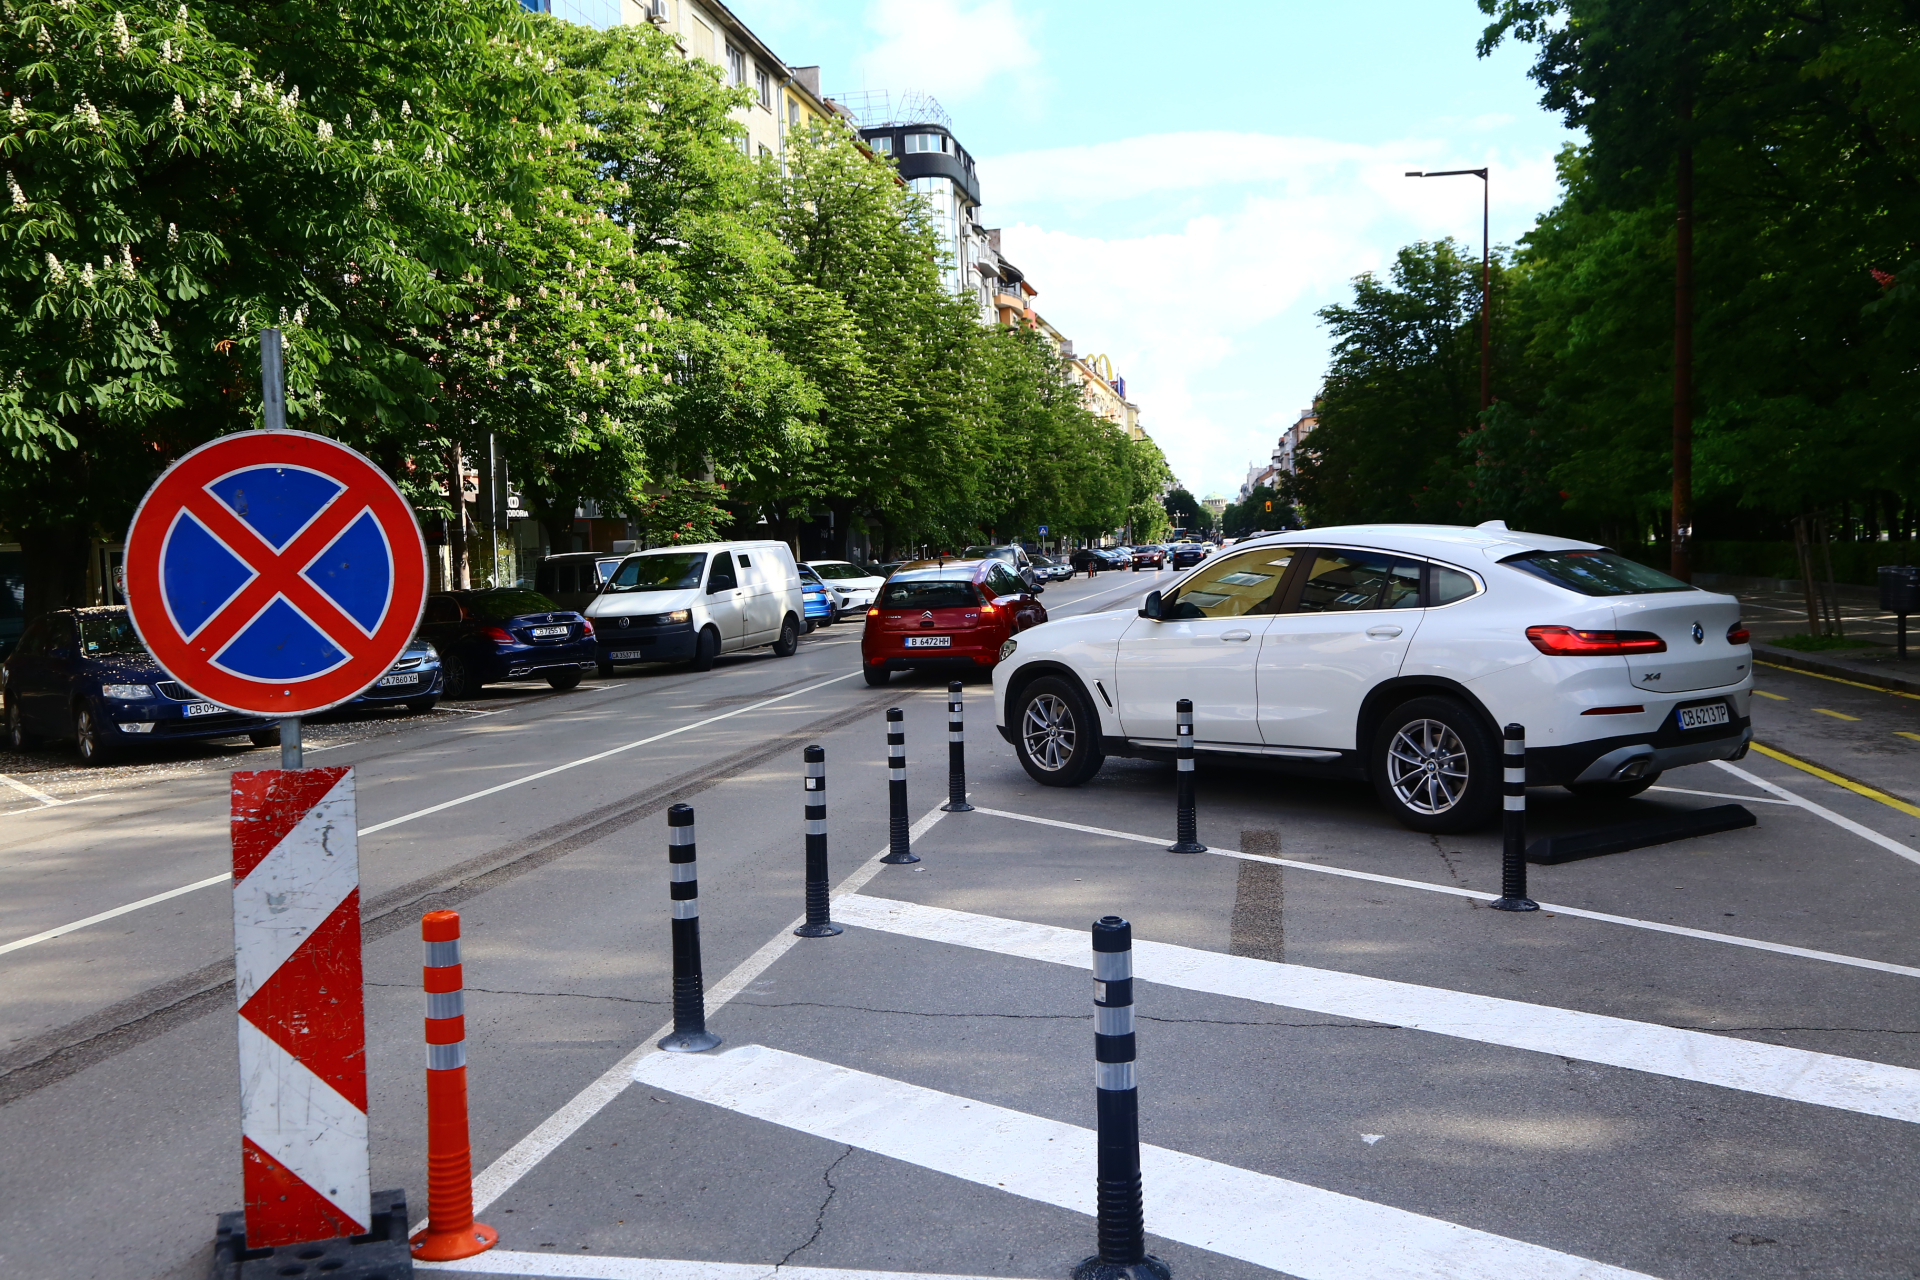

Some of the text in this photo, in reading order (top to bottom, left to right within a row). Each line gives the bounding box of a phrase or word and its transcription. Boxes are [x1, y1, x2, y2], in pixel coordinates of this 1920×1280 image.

[920, 638, 938, 646] 6472
[939, 637, 949, 645] HH
[380, 674, 418, 685] CA 7860 XH
[1642, 672, 1661, 682] X4
[189, 704, 202, 715] CB
[1682, 705, 1727, 727] CB 6213 TP
